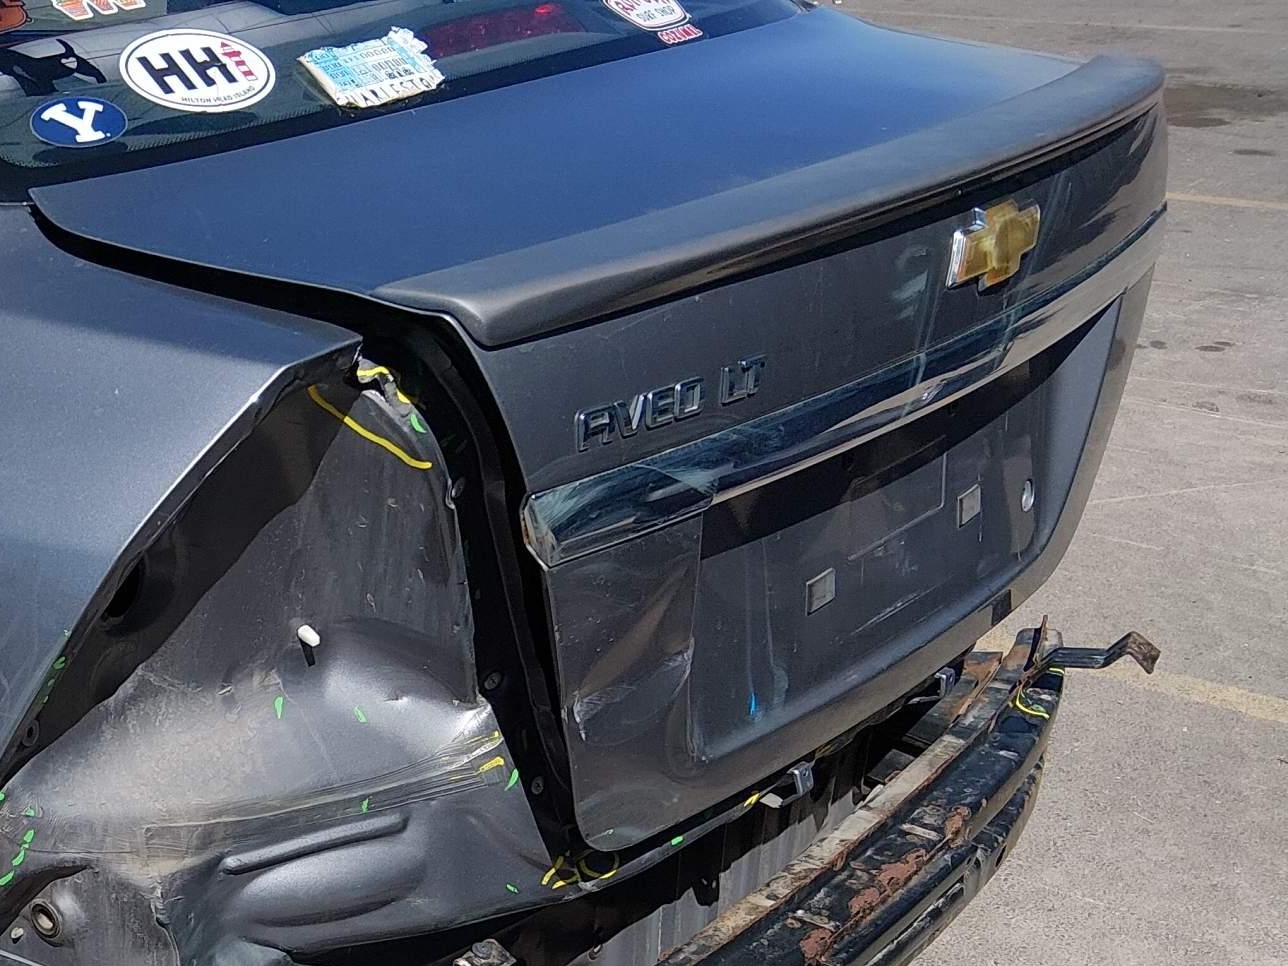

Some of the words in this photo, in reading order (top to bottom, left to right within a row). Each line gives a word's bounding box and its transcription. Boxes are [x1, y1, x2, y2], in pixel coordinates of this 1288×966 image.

[136, 46, 238, 95] HH
[181, 96, 212, 104] HILTON
[574, 376, 704, 453] AVEO
[719, 354, 768, 407] LT
